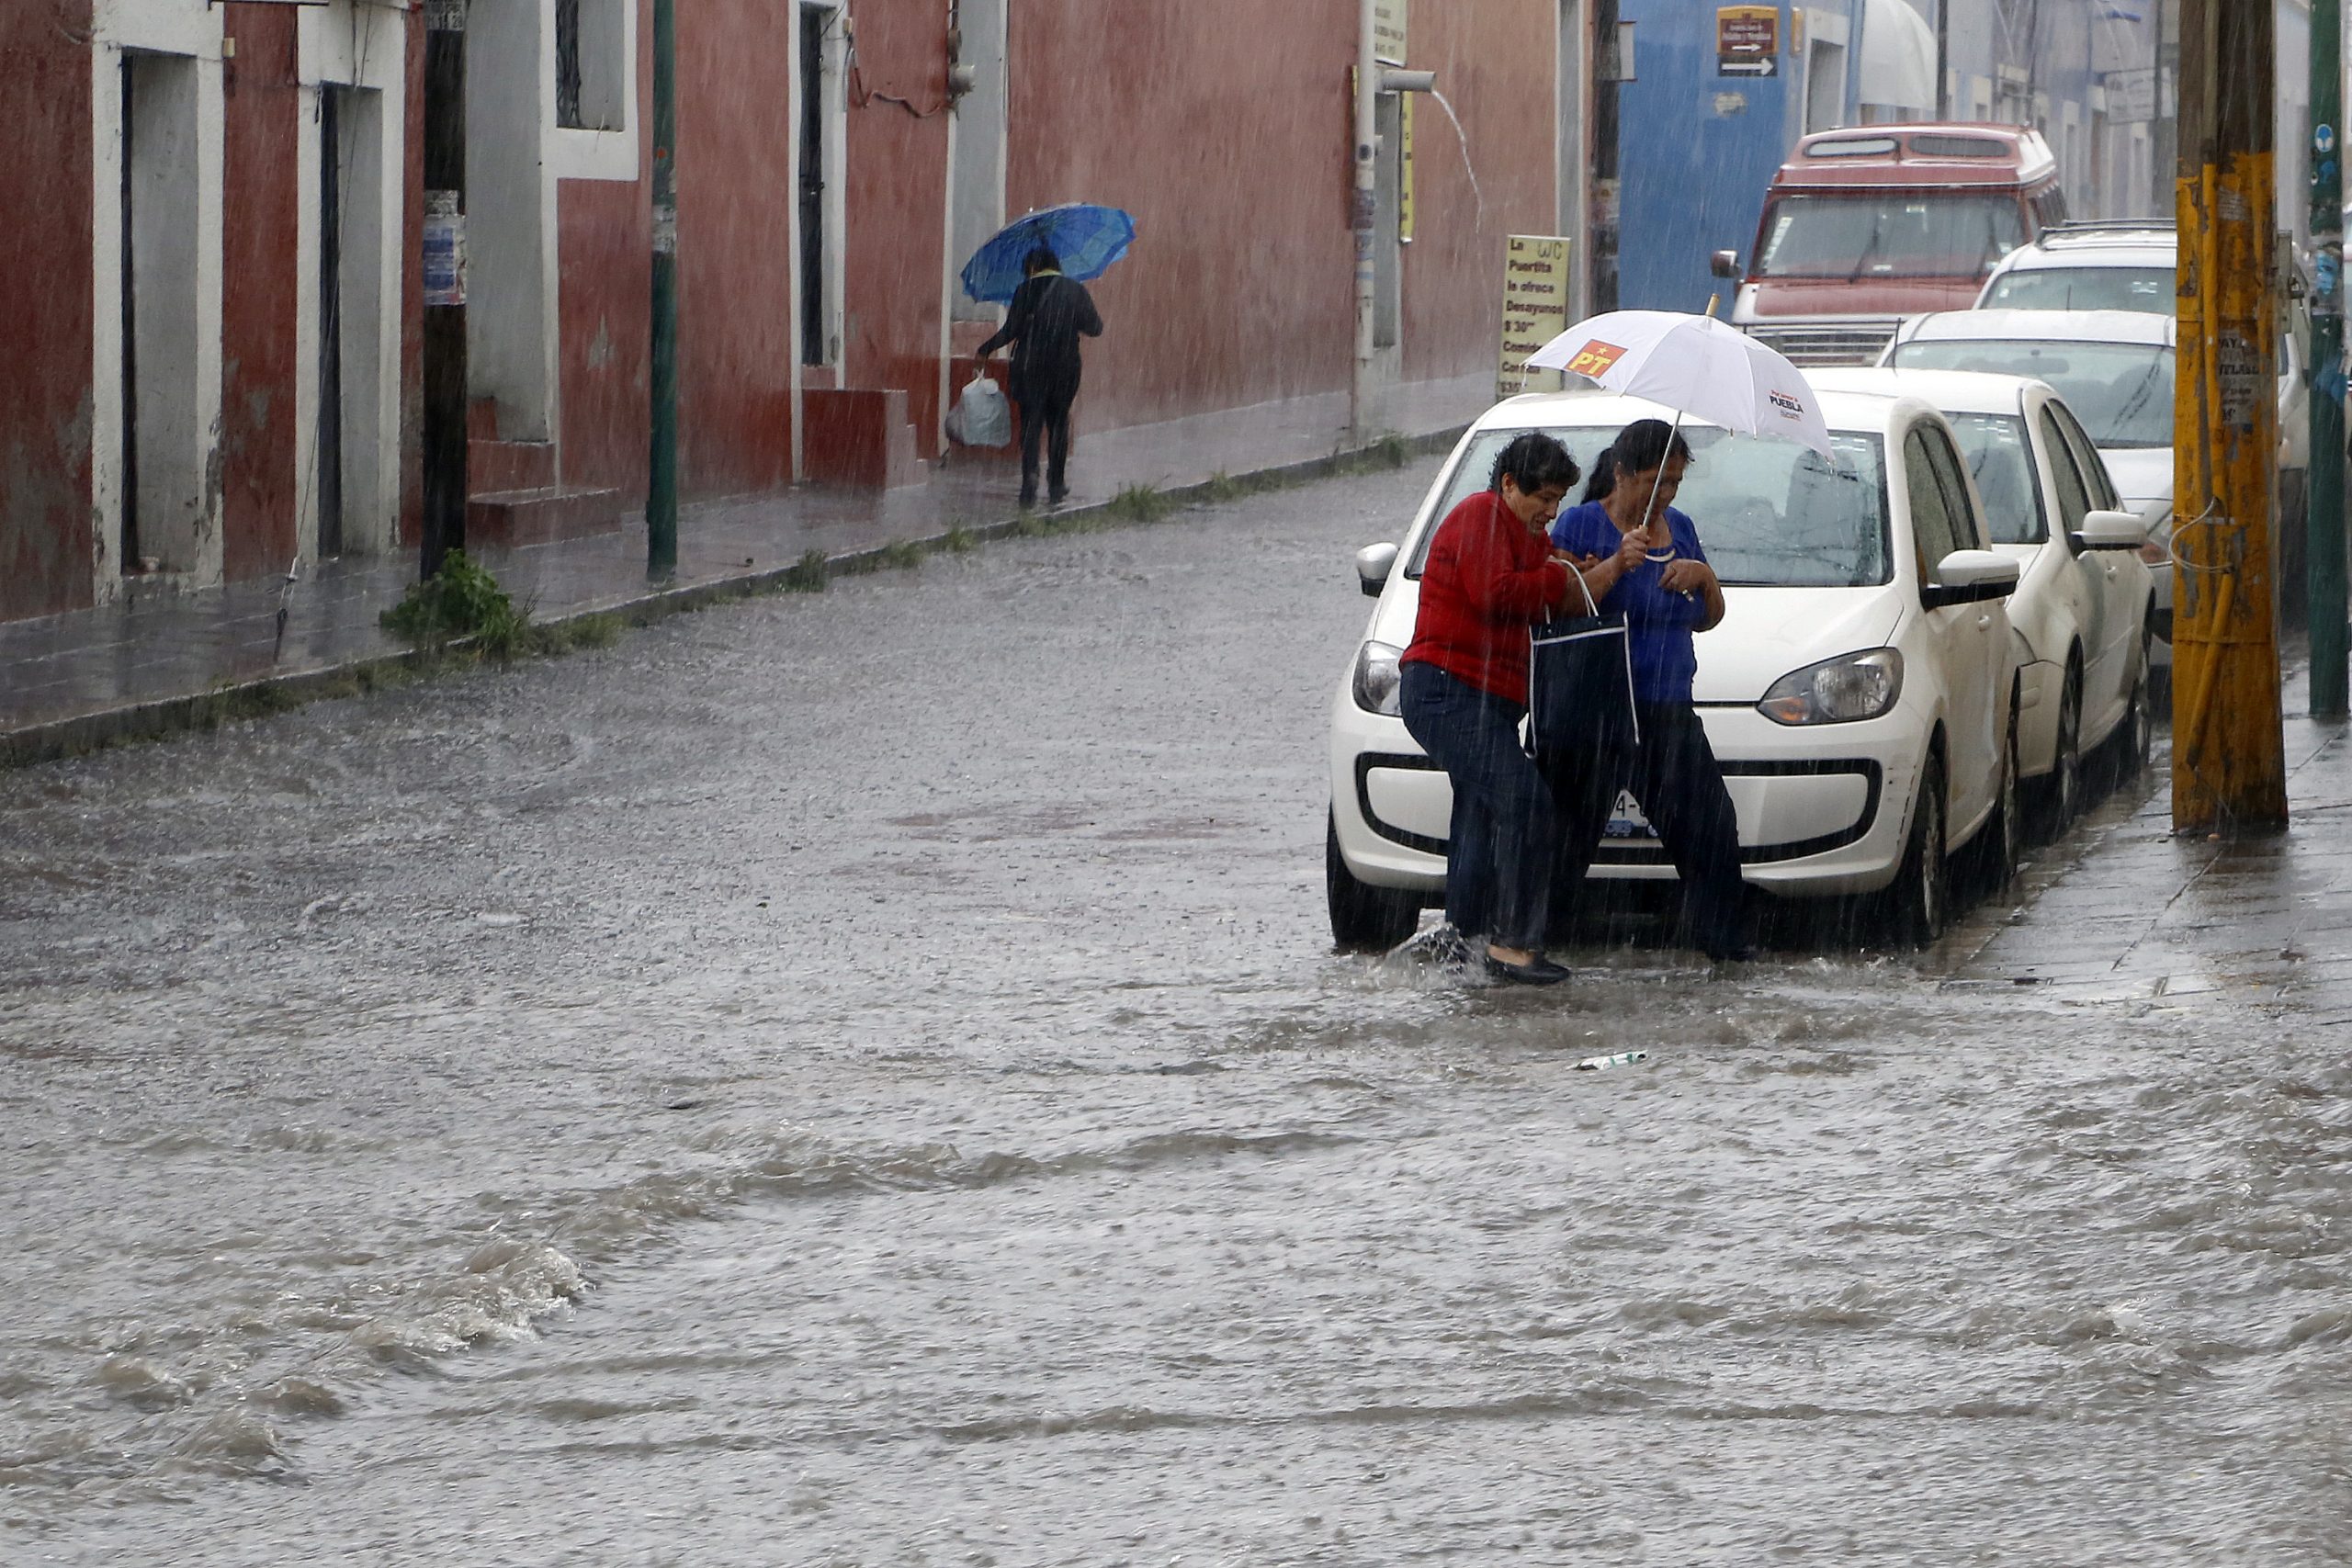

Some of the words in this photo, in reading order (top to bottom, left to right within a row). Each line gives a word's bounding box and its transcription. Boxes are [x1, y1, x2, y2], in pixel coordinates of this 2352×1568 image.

[1510, 239, 1524, 250] La
[1538, 242, 1562, 260] WC
[1506, 299, 1564, 315] Desayunos
[1568, 352, 1611, 375] PT
[1770, 395, 1804, 413] PUEBLA
